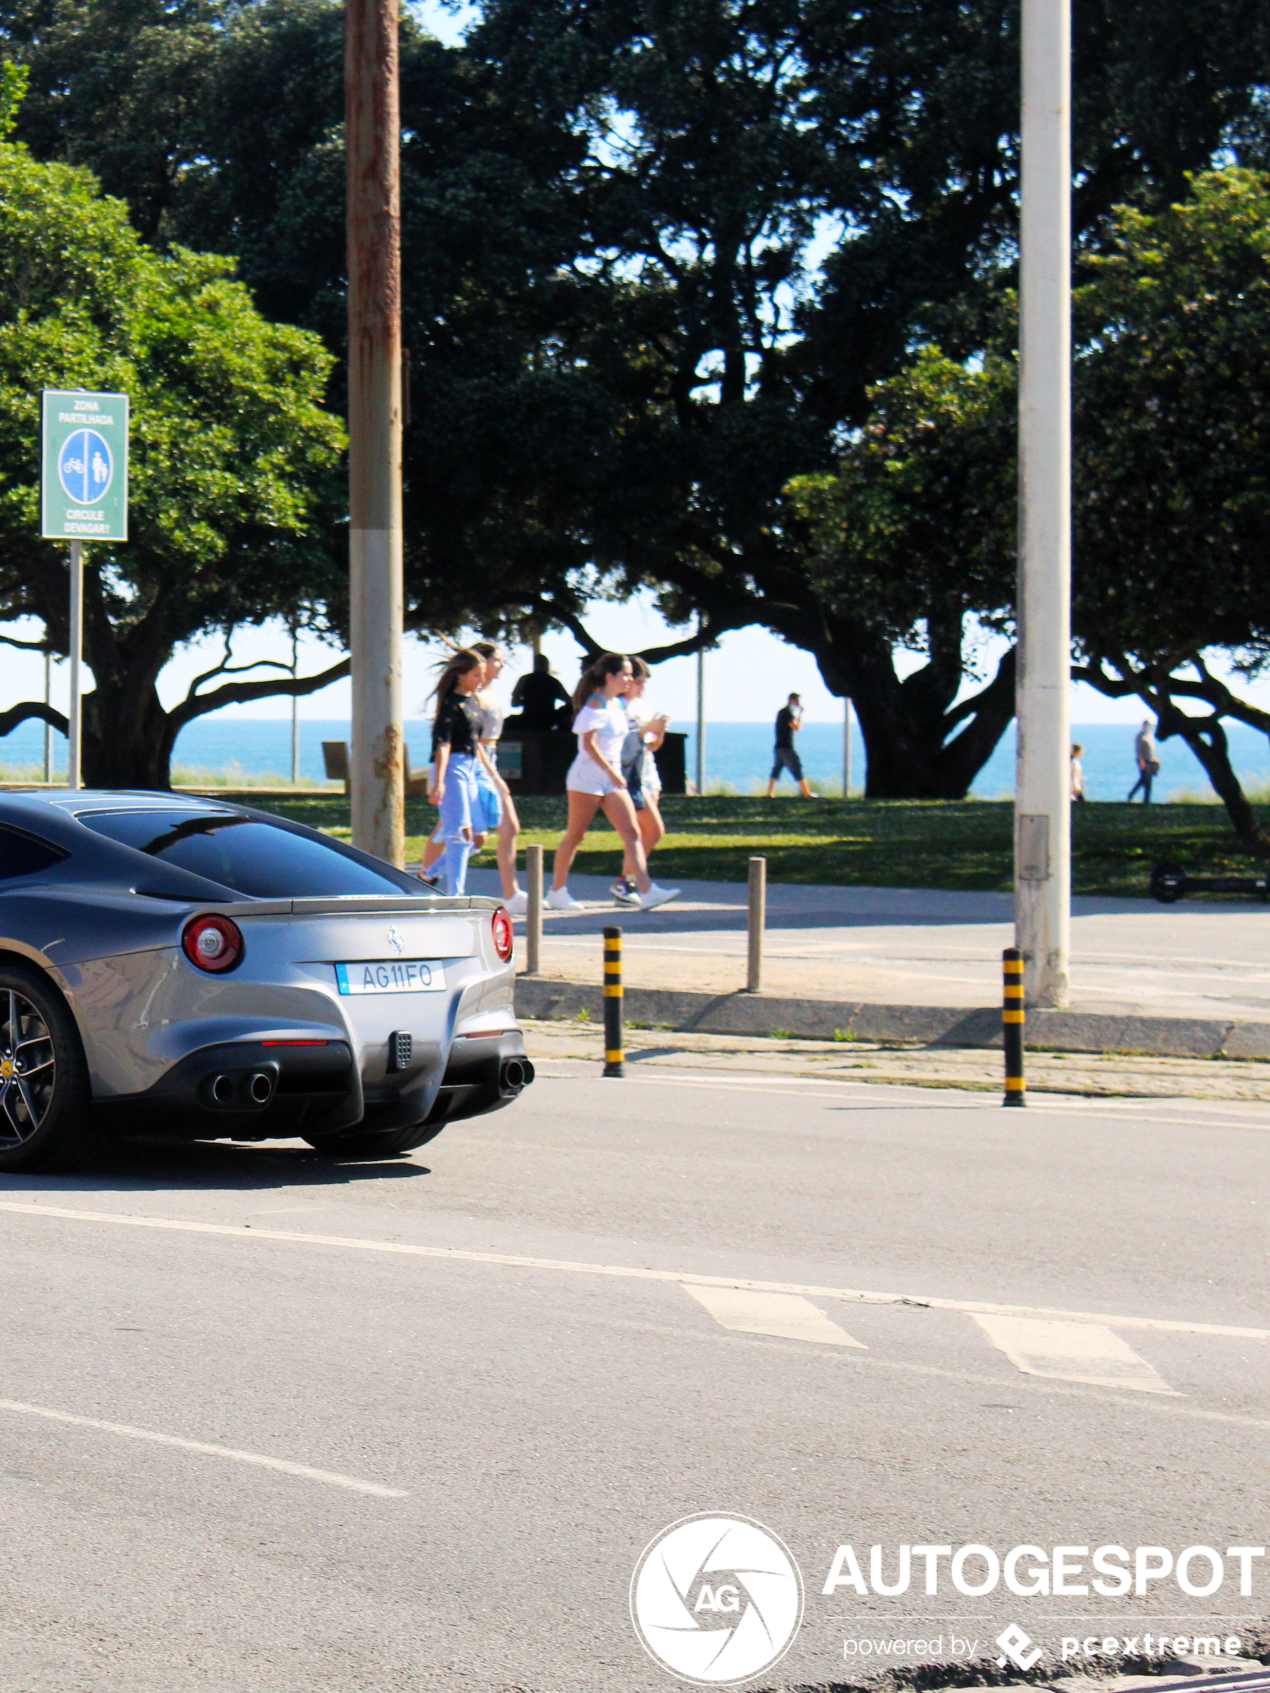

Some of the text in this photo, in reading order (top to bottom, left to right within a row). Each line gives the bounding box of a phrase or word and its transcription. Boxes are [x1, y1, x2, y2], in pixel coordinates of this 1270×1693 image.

[73, 400, 99, 411] ZONA
[59, 412, 114, 425] PARTILHADA
[66, 509, 104, 520] CIRCULE
